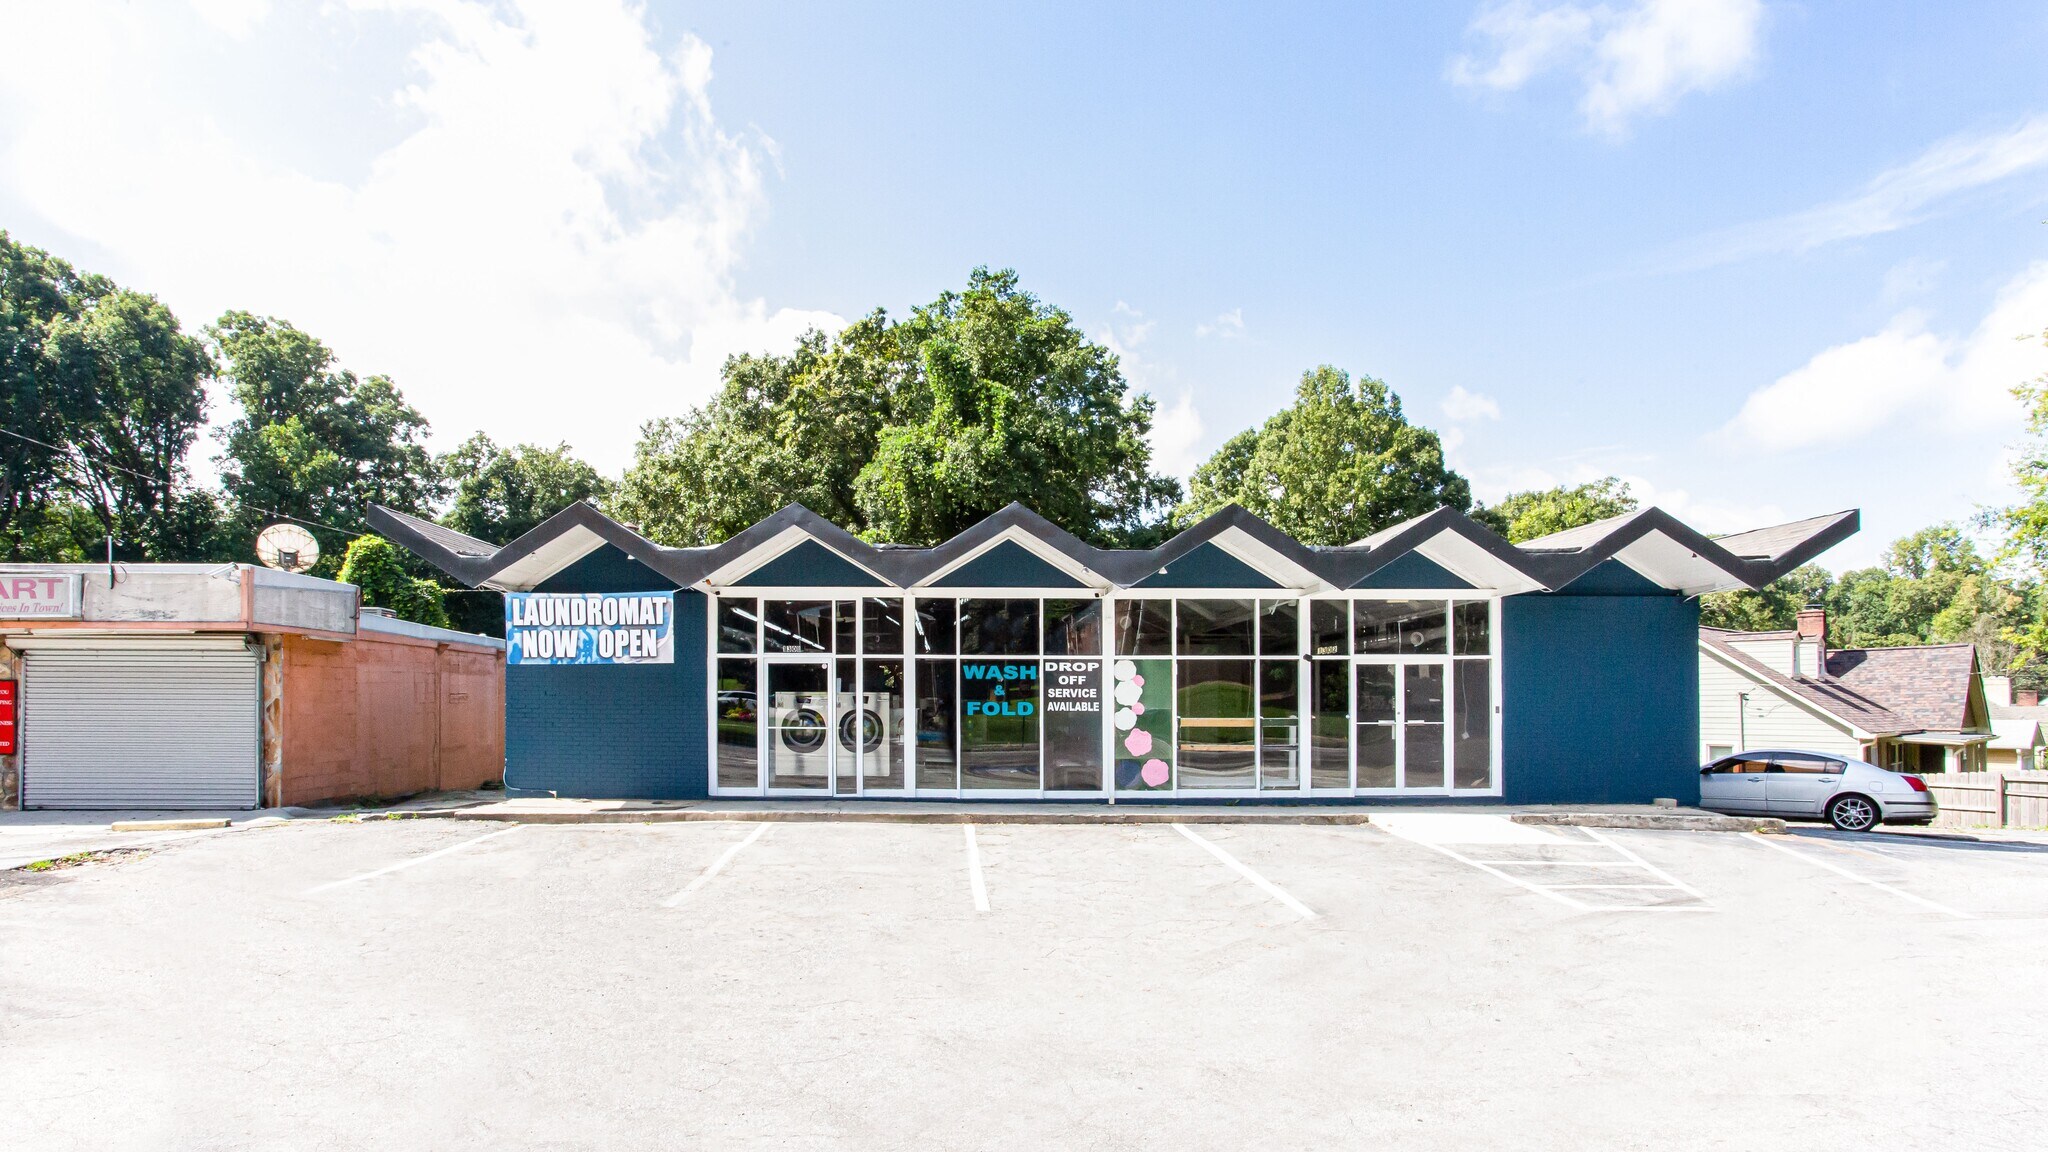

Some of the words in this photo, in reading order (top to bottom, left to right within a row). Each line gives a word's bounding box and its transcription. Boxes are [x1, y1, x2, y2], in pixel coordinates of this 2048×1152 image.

[19, 602, 30, 612] In
[33, 602, 64, 613] Town!
[512, 597, 667, 626] LAUNDROMAT
[522, 629, 578, 658] NOW
[598, 628, 657, 658] OPEN
[963, 665, 1037, 680] WASH
[1045, 662, 1100, 672] DROP
[1058, 675, 1086, 685] OFF
[994, 685, 1005, 696] &
[1047, 688, 1097, 698] SERVICE
[967, 701, 1034, 716] FOLD
[1047, 701, 1100, 712] AVAILABLE
